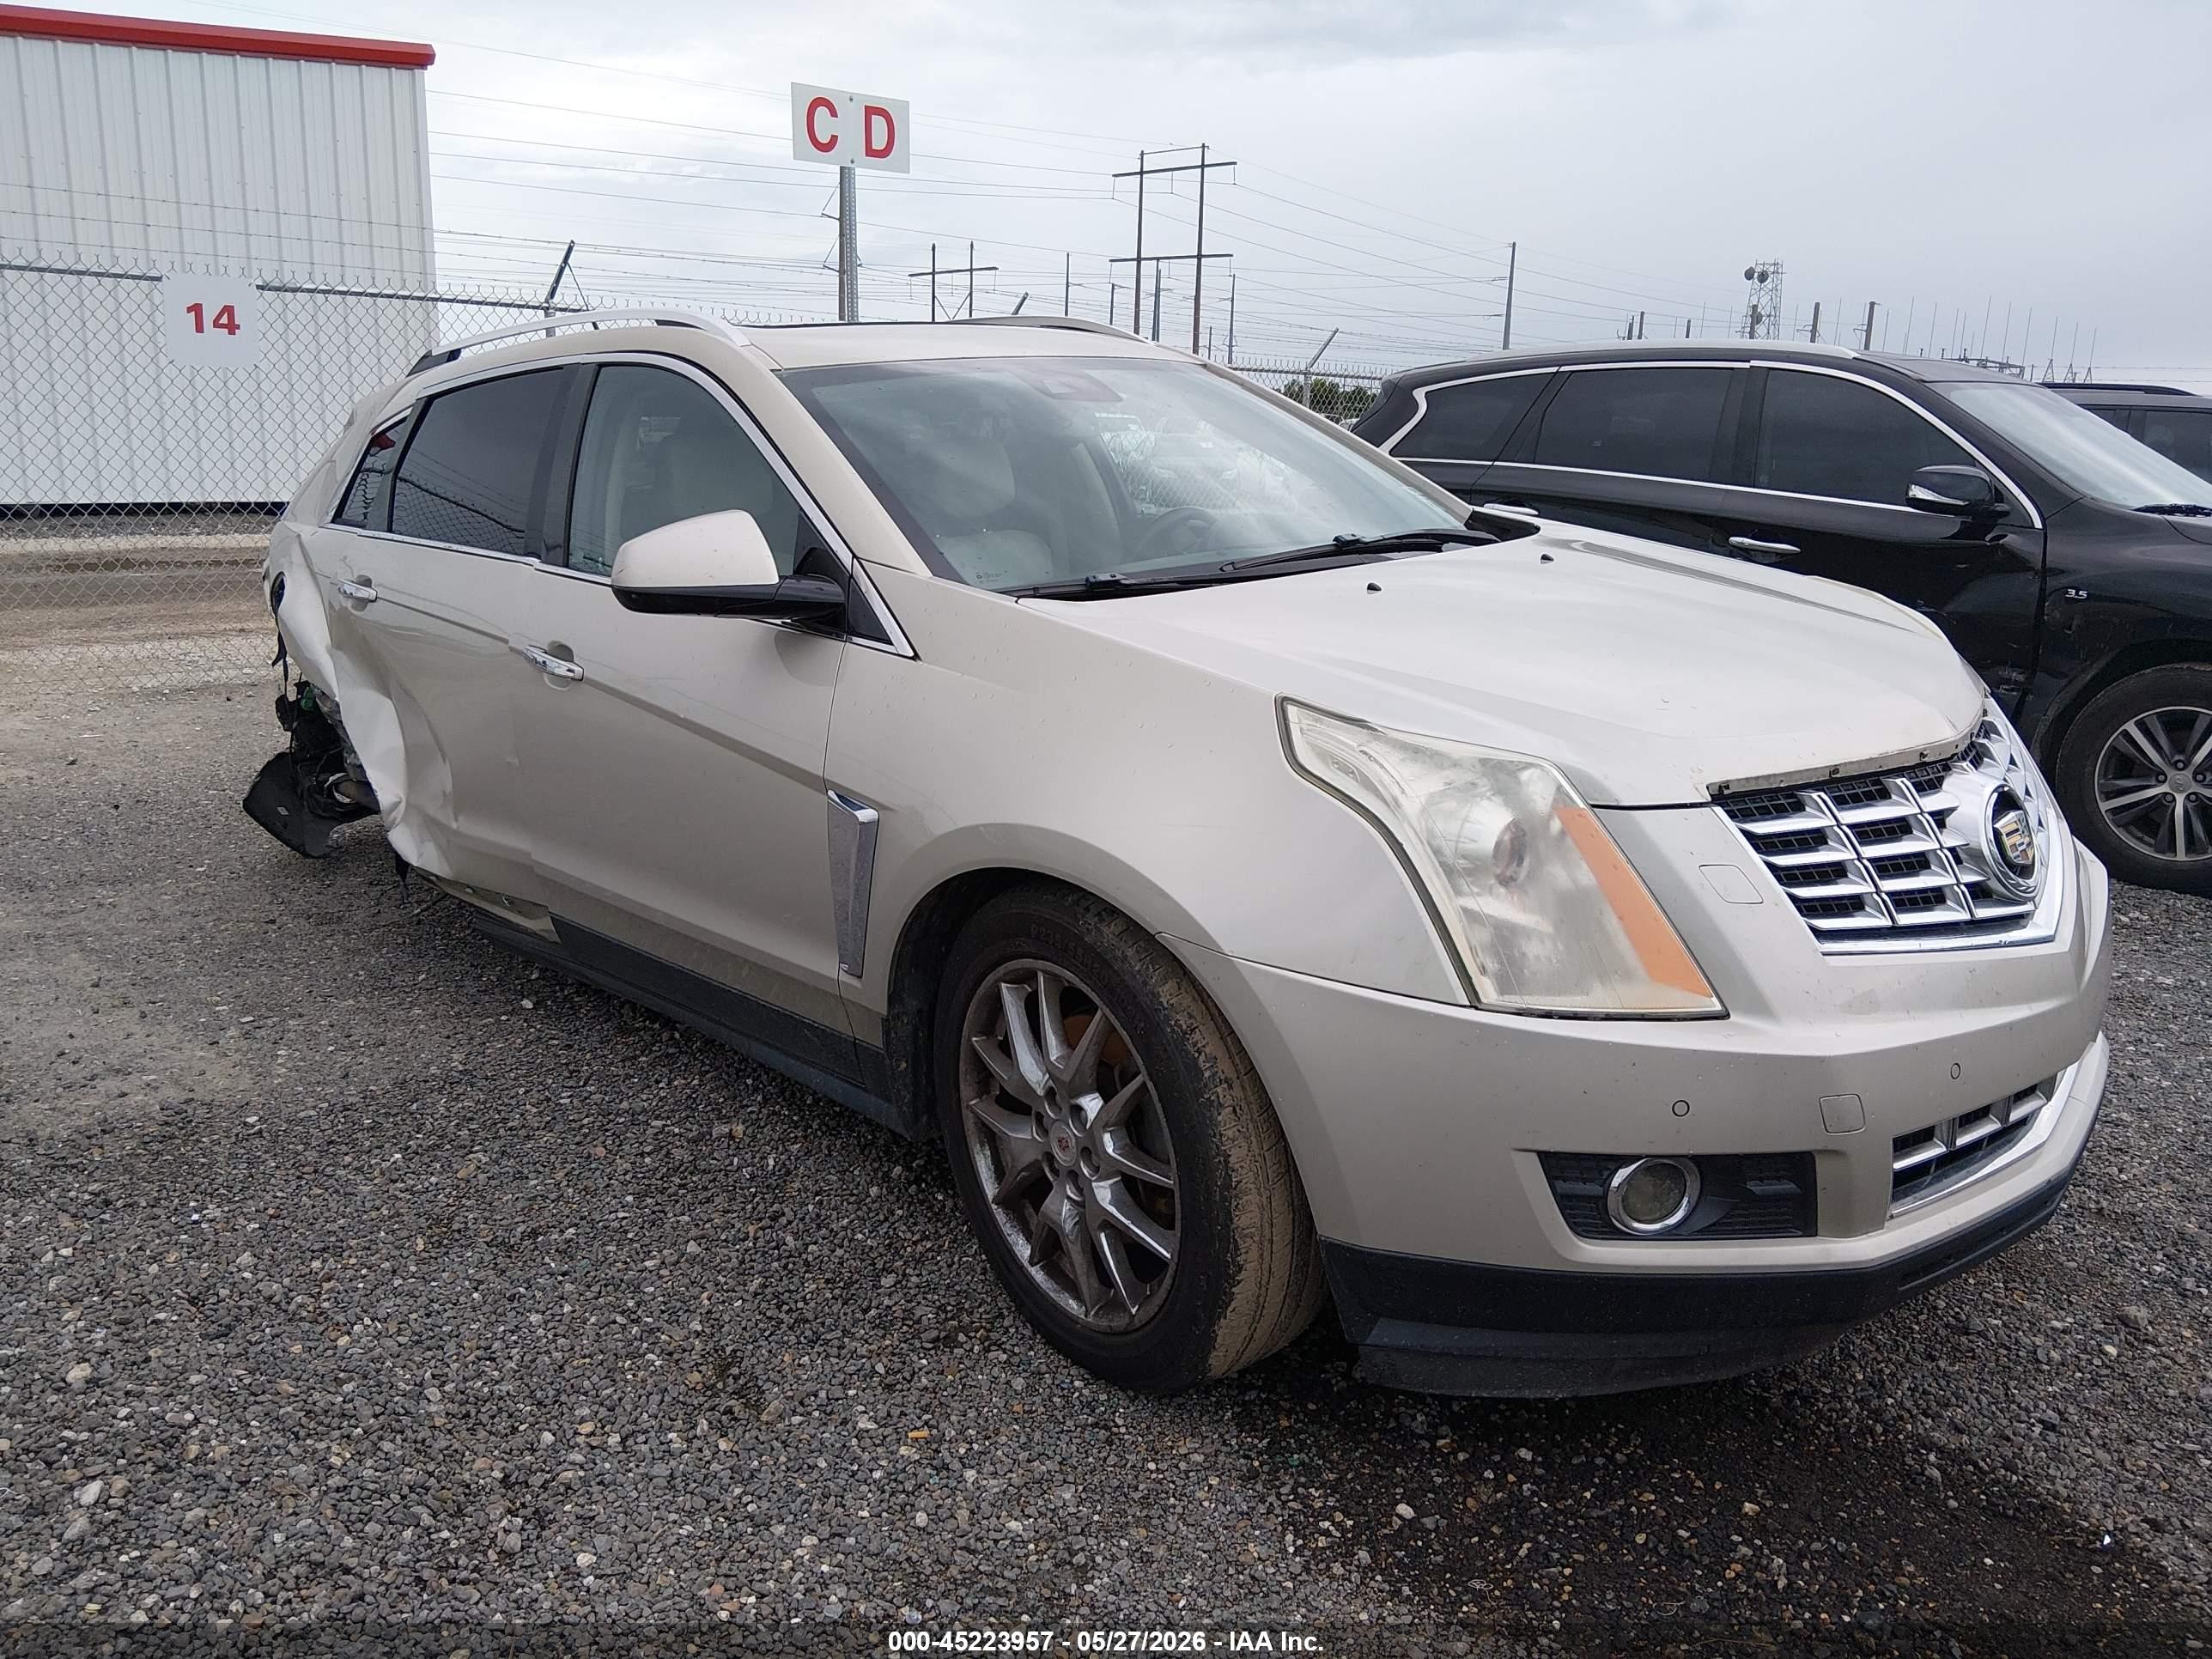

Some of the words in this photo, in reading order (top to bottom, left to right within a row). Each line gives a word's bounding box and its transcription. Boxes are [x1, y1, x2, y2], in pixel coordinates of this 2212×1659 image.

[805, 96, 839, 153] C
[864, 105, 896, 159] D
[186, 302, 240, 336] 14
